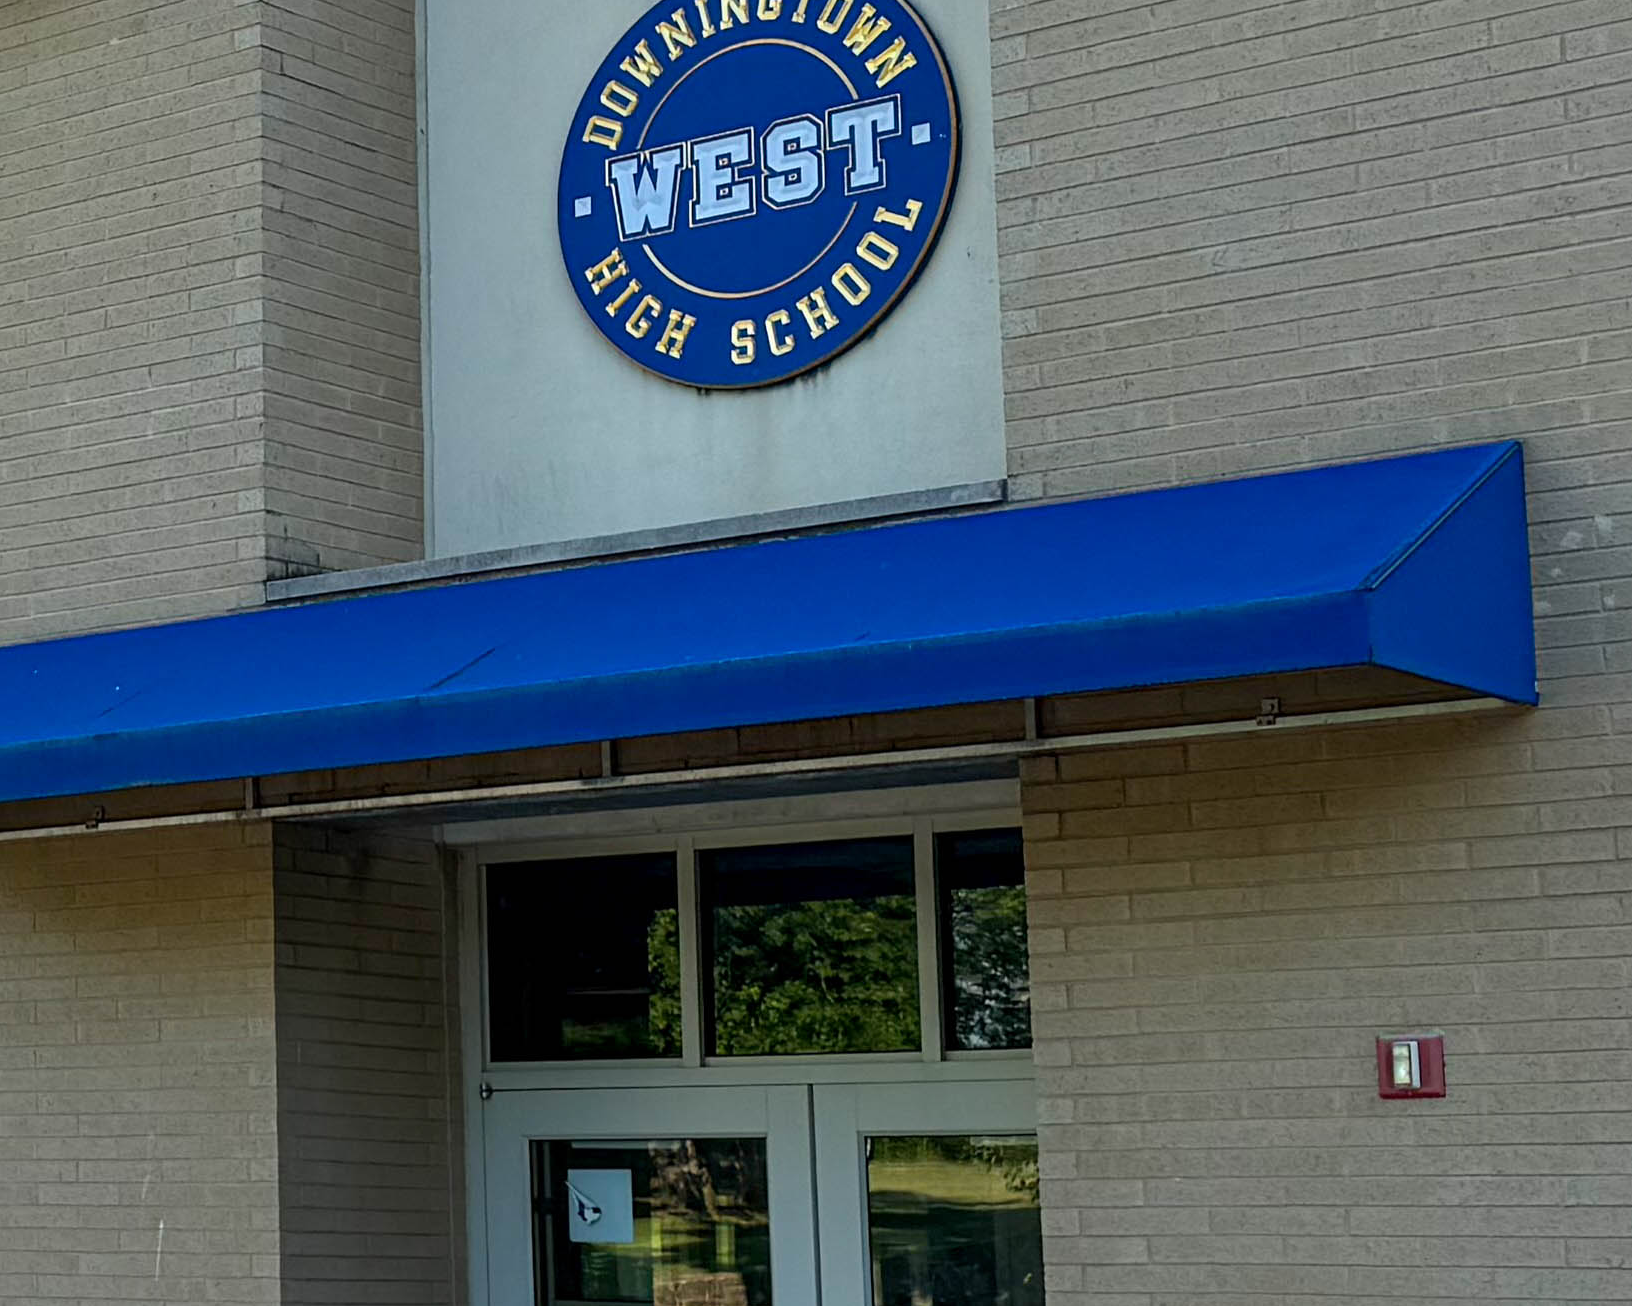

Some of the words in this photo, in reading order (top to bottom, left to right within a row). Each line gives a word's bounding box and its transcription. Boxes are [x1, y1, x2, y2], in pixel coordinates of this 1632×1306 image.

[605, 93, 902, 242] WEST
[584, 246, 698, 359] HIGH
[730, 198, 923, 365] SCHOOL
